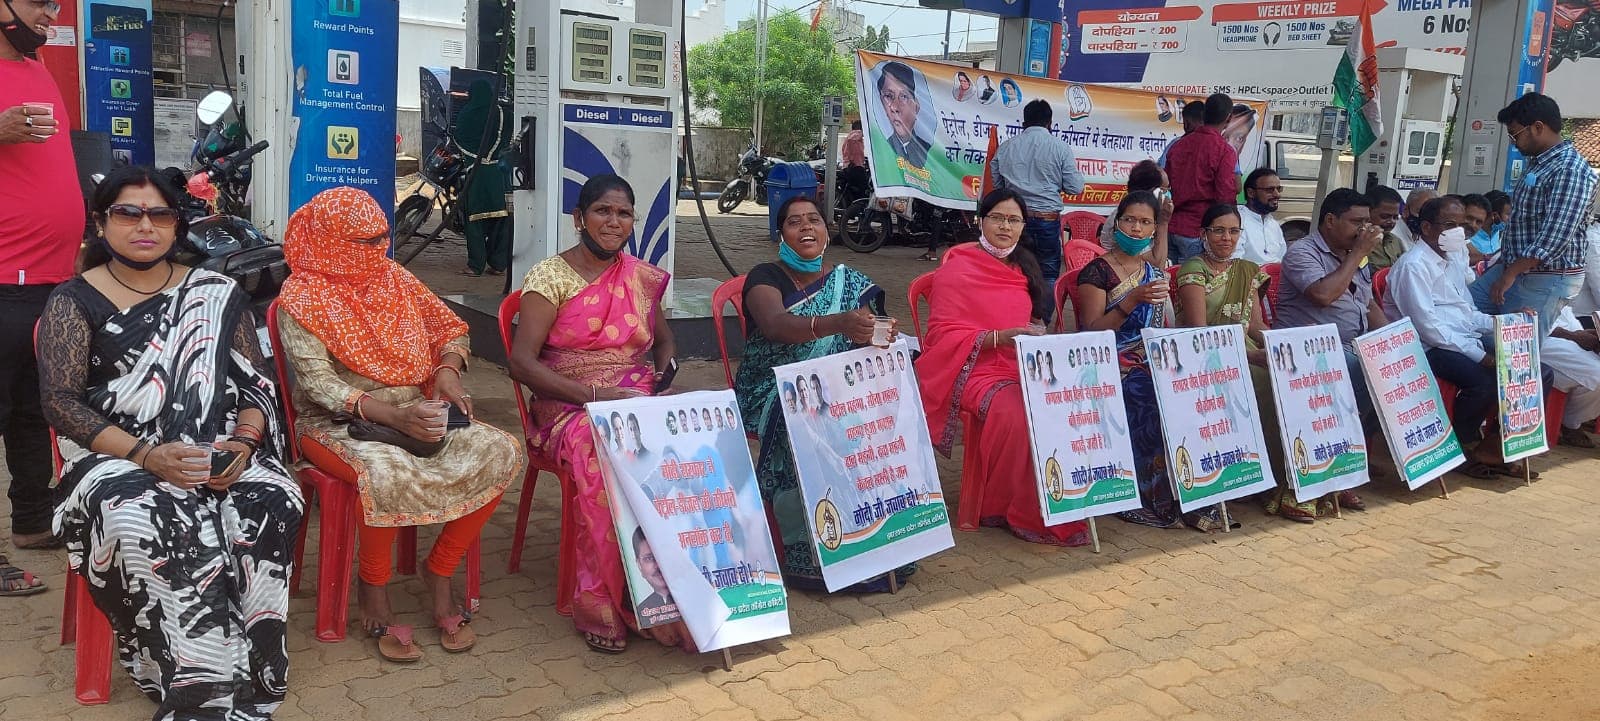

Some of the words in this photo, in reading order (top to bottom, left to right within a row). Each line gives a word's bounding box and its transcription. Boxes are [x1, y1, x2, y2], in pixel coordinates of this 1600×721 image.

[1258, 4, 1300, 17] WEEKLY
[1304, 2, 1336, 15] PRIZE
[1117, 11, 1160, 22] योग्यता
[313, 20, 346, 32] Reward
[349, 24, 374, 36] Points
[1092, 25, 1136, 37] दोपहिया
[1158, 26, 1176, 34] 200
[1222, 25, 1242, 34] 1500
[1244, 24, 1259, 33] Nos
[1286, 23, 1307, 32] 1500
[1309, 22, 1326, 31] Nos
[1423, 16, 1435, 34] 6
[1222, 35, 1257, 43] HEADPHONE
[1301, 33, 1321, 41] SHEET
[1161, 41, 1178, 50] 700
[323, 88, 343, 99] Total
[346, 91, 363, 101] Fuel
[1154, 86, 1207, 94] PARTICIPATE
[1213, 86, 1231, 94] SMS
[299, 97, 354, 110] Management
[356, 102, 386, 112] Control
[576, 108, 609, 121] Diesel
[632, 113, 662, 124] Diesel
[1101, 128, 1134, 153] बेतहाशा
[945, 141, 961, 162] को
[963, 142, 988, 166] लेक
[315, 163, 355, 175] Insurance
[358, 166, 370, 175] for
[306, 173, 336, 184] Drivers
[338, 174, 345, 184] &
[346, 175, 378, 187] Helpers
[1081, 184, 1108, 202] जिला
[853, 502, 874, 526] मोदी
[872, 497, 886, 520] जी
[884, 495, 907, 514] जवाब
[712, 568, 738, 587] जवाब
